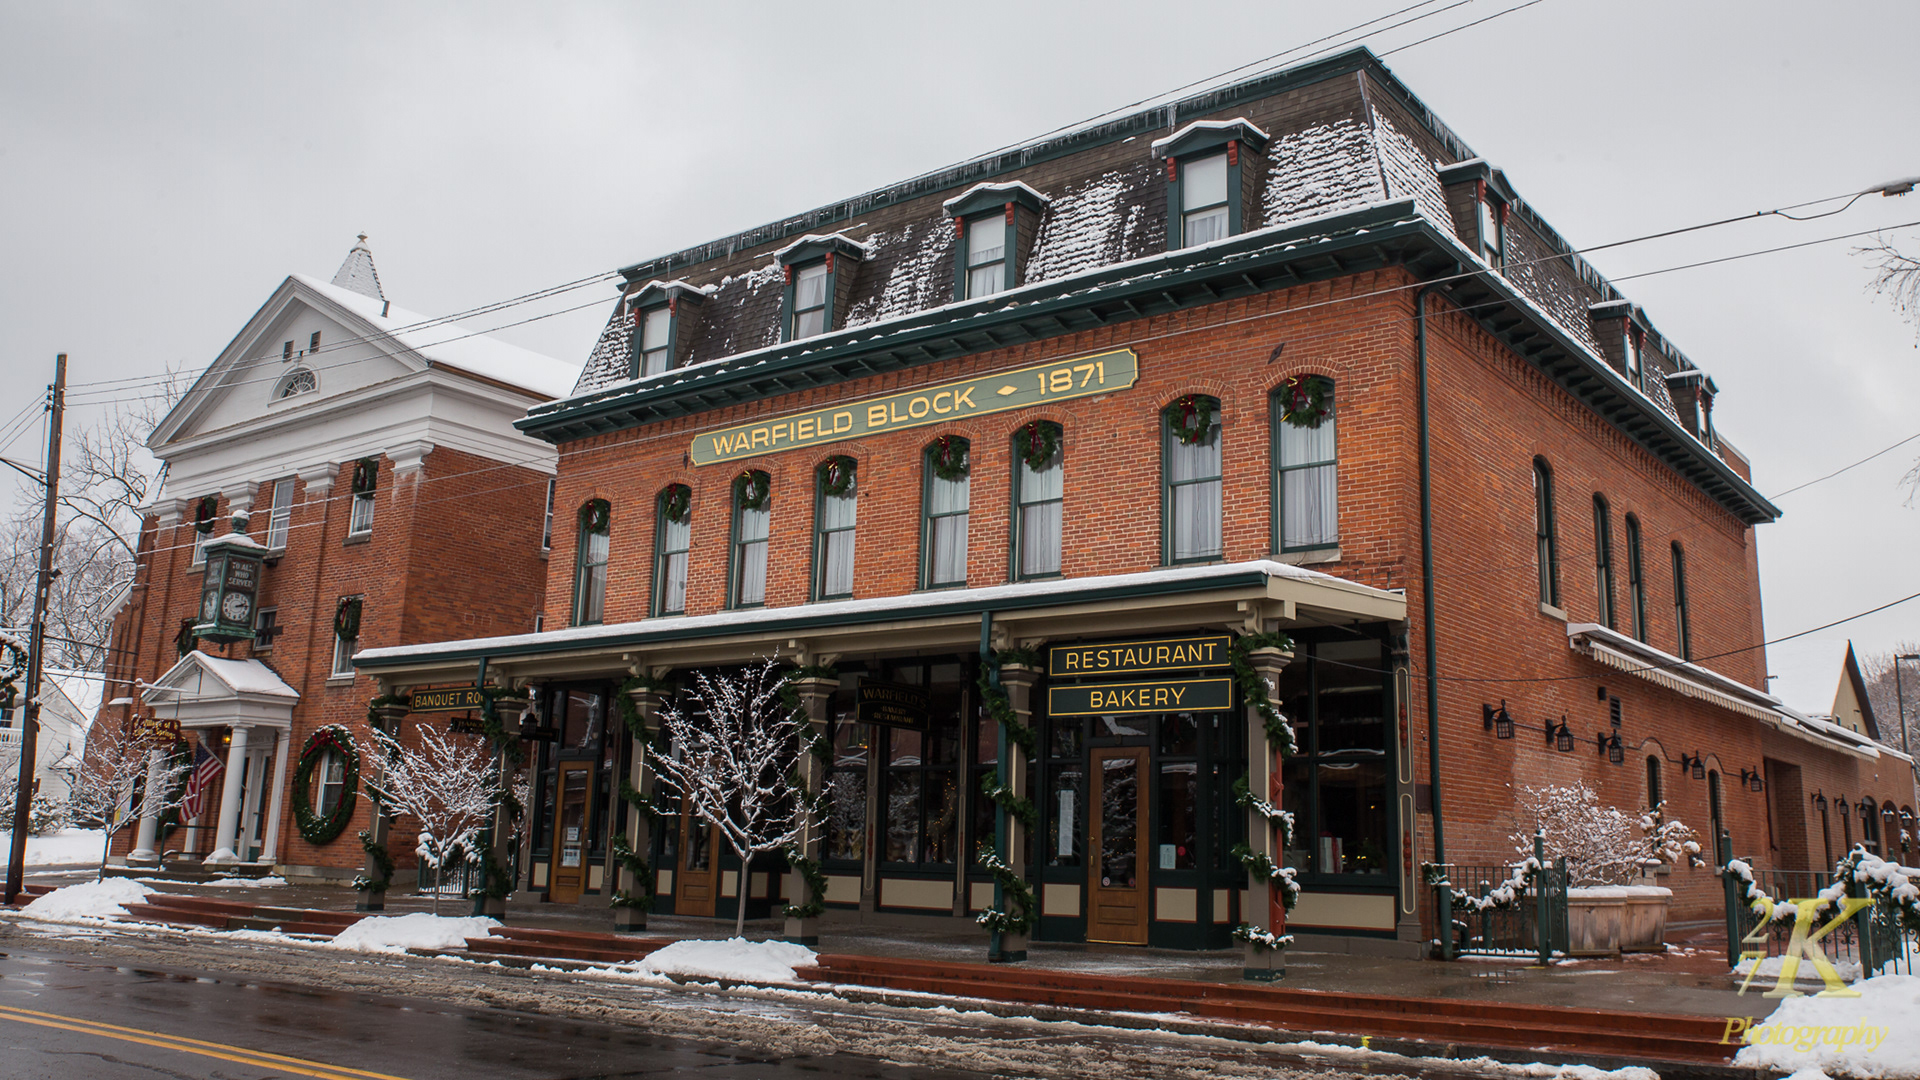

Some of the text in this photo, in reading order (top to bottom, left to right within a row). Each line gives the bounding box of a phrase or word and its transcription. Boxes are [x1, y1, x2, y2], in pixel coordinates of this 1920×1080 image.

[712, 361, 1106, 456] WARFIELD BLOCK 1871
[228, 577, 254, 587] SERVED
[1065, 643, 1218, 670] RESTAURANT
[415, 691, 485, 707] BANQUET RO
[863, 688, 927, 708] WARFIELD'S
[1090, 686, 1187, 708] BAKERY
